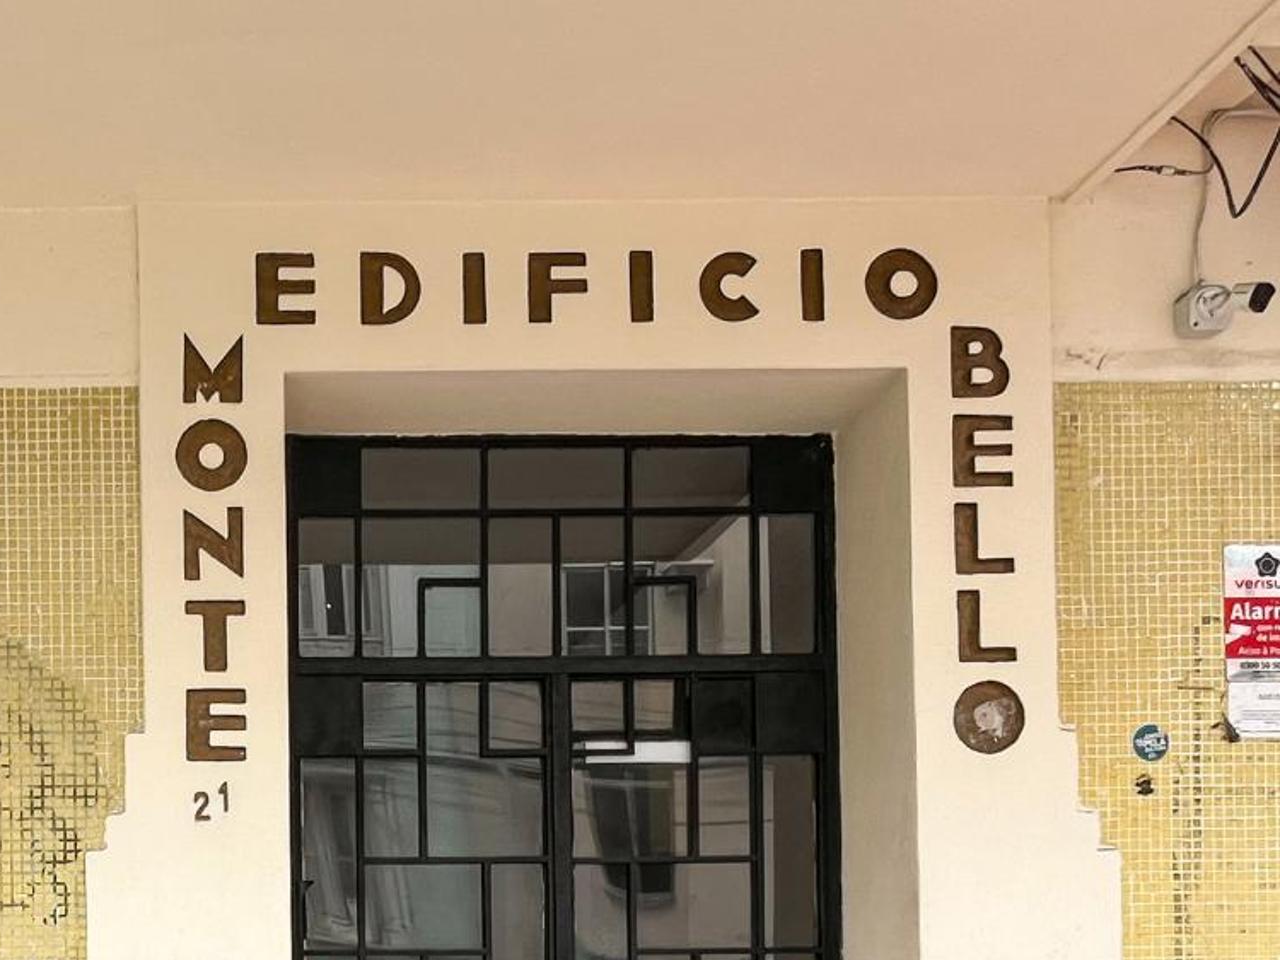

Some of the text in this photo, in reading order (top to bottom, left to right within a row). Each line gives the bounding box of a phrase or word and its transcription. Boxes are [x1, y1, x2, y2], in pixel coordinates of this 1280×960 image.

[255, 246, 939, 326] EDIFICIO
[175, 332, 248, 762] MONTE
[950, 325, 1026, 756] BELLO
[193, 780, 229, 822] 21
